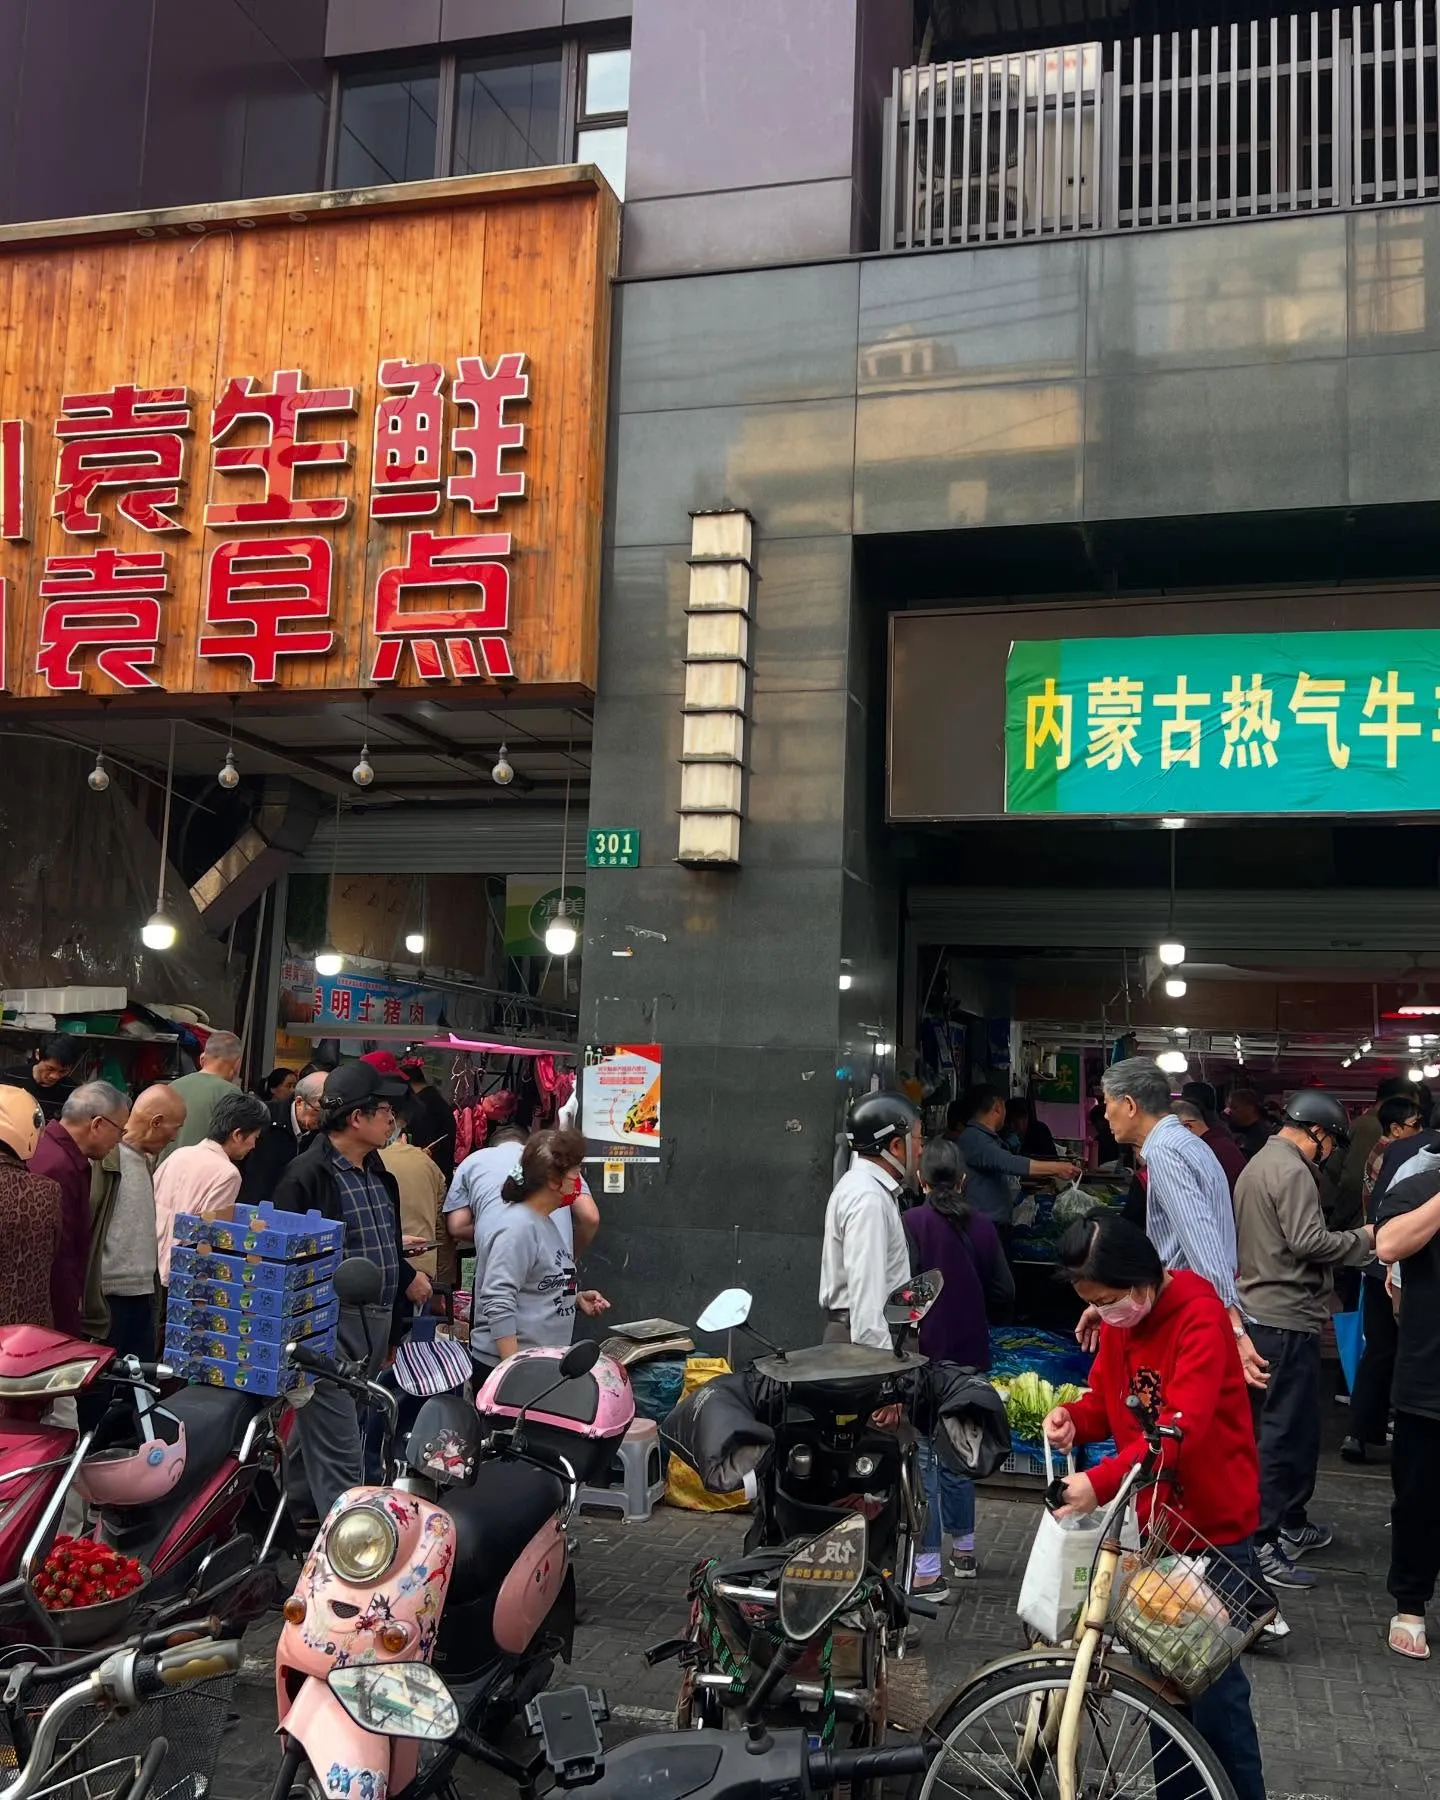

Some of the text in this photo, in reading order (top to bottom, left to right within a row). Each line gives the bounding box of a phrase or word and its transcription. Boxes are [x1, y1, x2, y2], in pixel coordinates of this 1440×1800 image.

[0, 353, 529, 538] 袁生鲜
[0, 530, 515, 691] 袁早点
[1024, 671, 1440, 770] 内蒙古热气牛
[595, 833, 632, 854] 301
